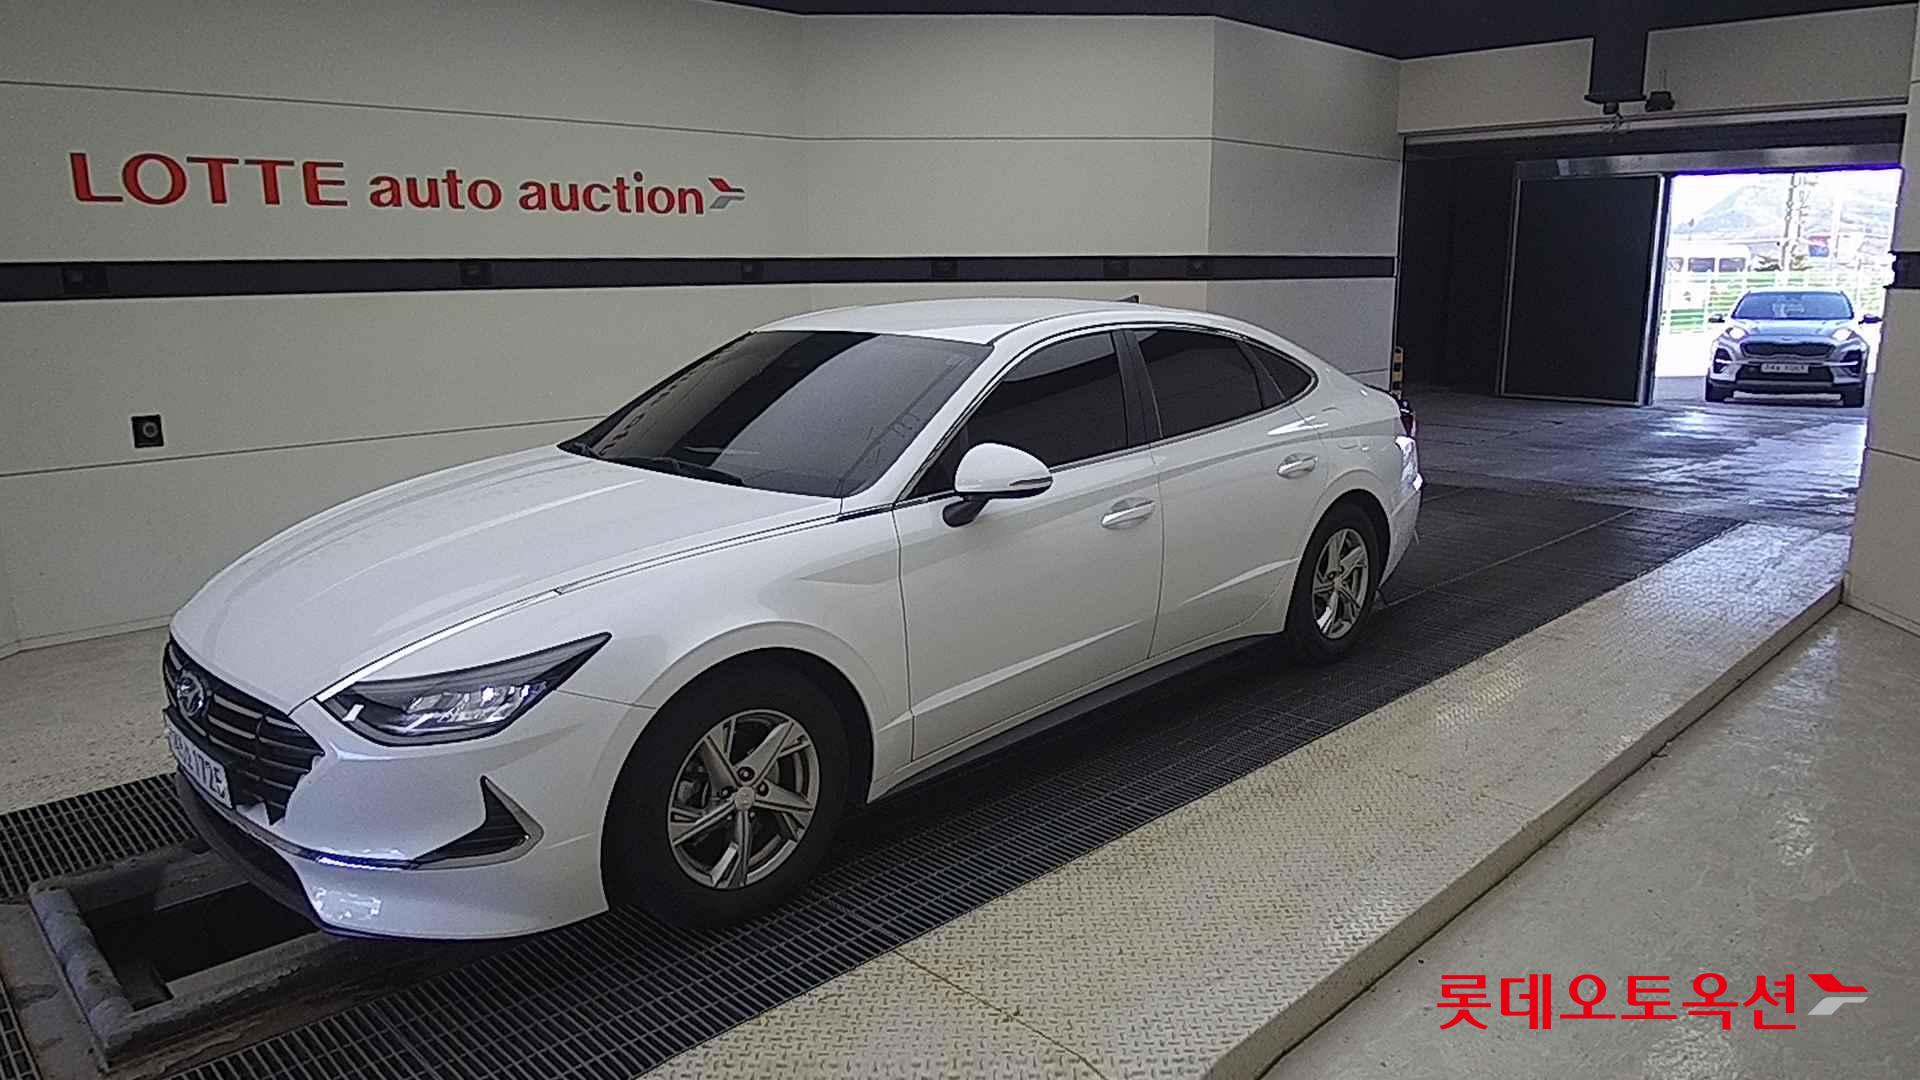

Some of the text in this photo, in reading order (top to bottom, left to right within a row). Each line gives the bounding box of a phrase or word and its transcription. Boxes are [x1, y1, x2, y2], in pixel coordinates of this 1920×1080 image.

[70, 152, 705, 215] LOTTE auto auction
